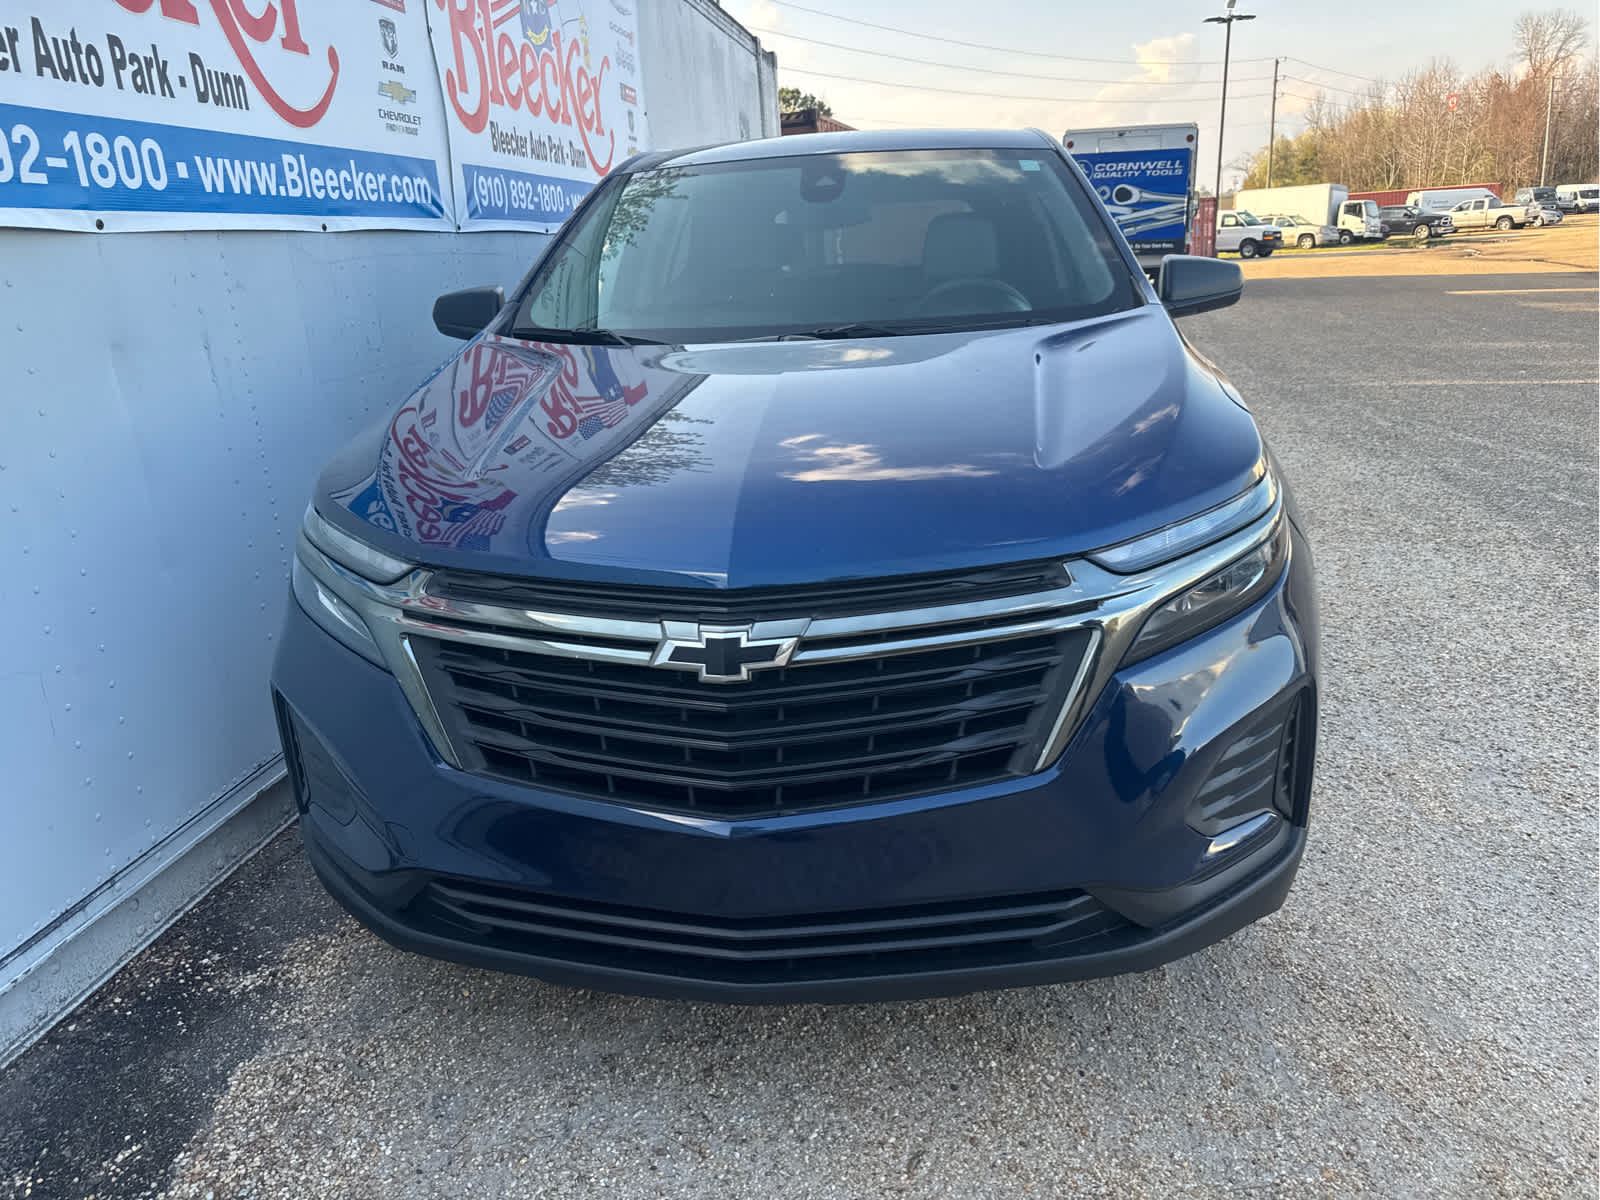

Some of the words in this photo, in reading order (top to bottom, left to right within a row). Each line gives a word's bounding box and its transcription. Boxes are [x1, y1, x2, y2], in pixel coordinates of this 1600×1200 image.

[31, 17, 104, 87] Auto
[106, 33, 176, 99] Park
[189, 52, 250, 111] Dunn
[382, 61, 405, 74] RAM
[434, 0, 615, 177] Bleecker
[378, 108, 421, 126] CHEVROLET
[489, 120, 529, 158] Bleecker
[529, 130, 548, 161] Auto
[548, 134, 566, 166] Park
[569, 140, 587, 168] Dunn
[1095, 160, 1184, 171] CORNWELL
[194, 153, 432, 204] www.Bleecker.com
[473, 170, 509, 215] (910)
[509, 179, 565, 213] 892-1800
[1094, 170, 1141, 179] QUALITY
[1145, 168, 1183, 177] TOOLS
